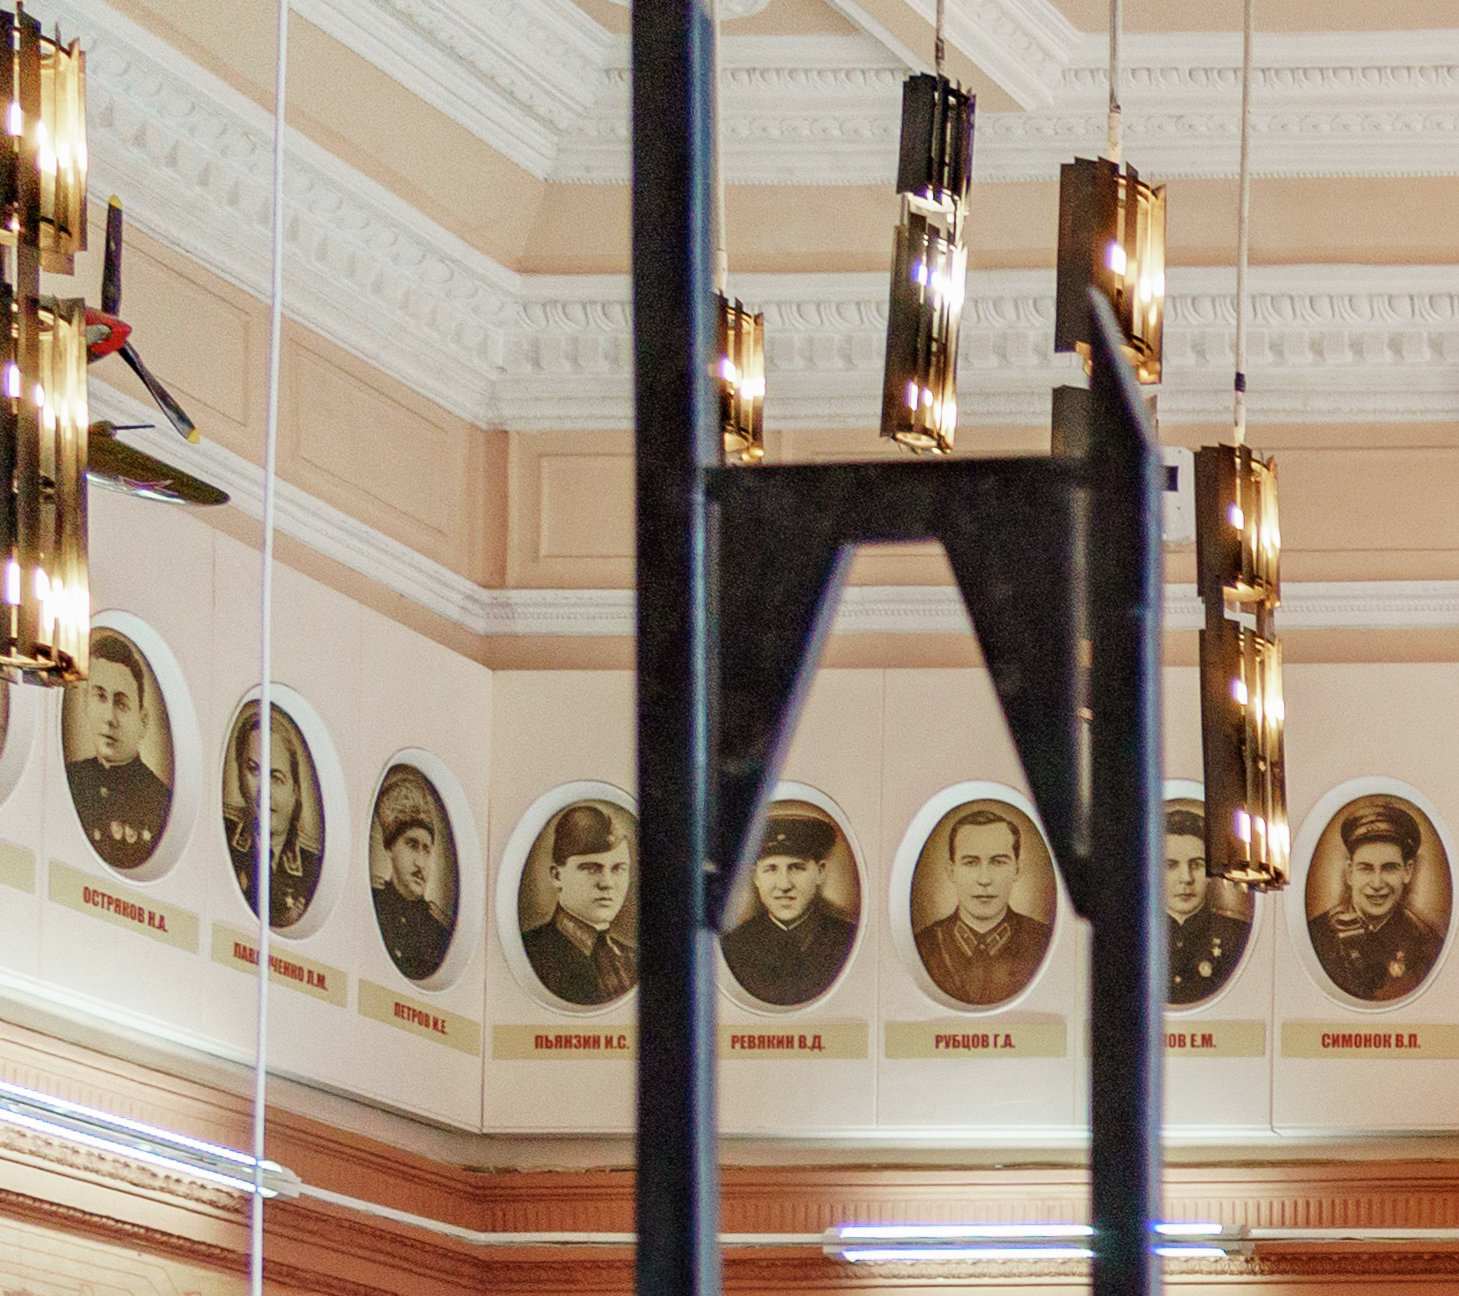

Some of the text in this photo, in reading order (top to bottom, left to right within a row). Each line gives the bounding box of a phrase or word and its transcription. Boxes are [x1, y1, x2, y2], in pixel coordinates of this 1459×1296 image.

[82, 885, 145, 924] ОСТРЯКОВ
[233, 941, 305, 983] ПАВЛЧЕНКО
[393, 1001, 433, 1029] ПЕТРОВ
[533, 1034, 630, 1050] ПЬЯНЗИН И.С.
[730, 1034, 826, 1052] РЕВЯКИН В.Д.
[934, 1033, 1016, 1052] РУБЦОВ Г.А.
[1190, 1033, 1217, 1049] Е.М.
[1321, 1033, 1422, 1049] СИМОНОК В.П.
